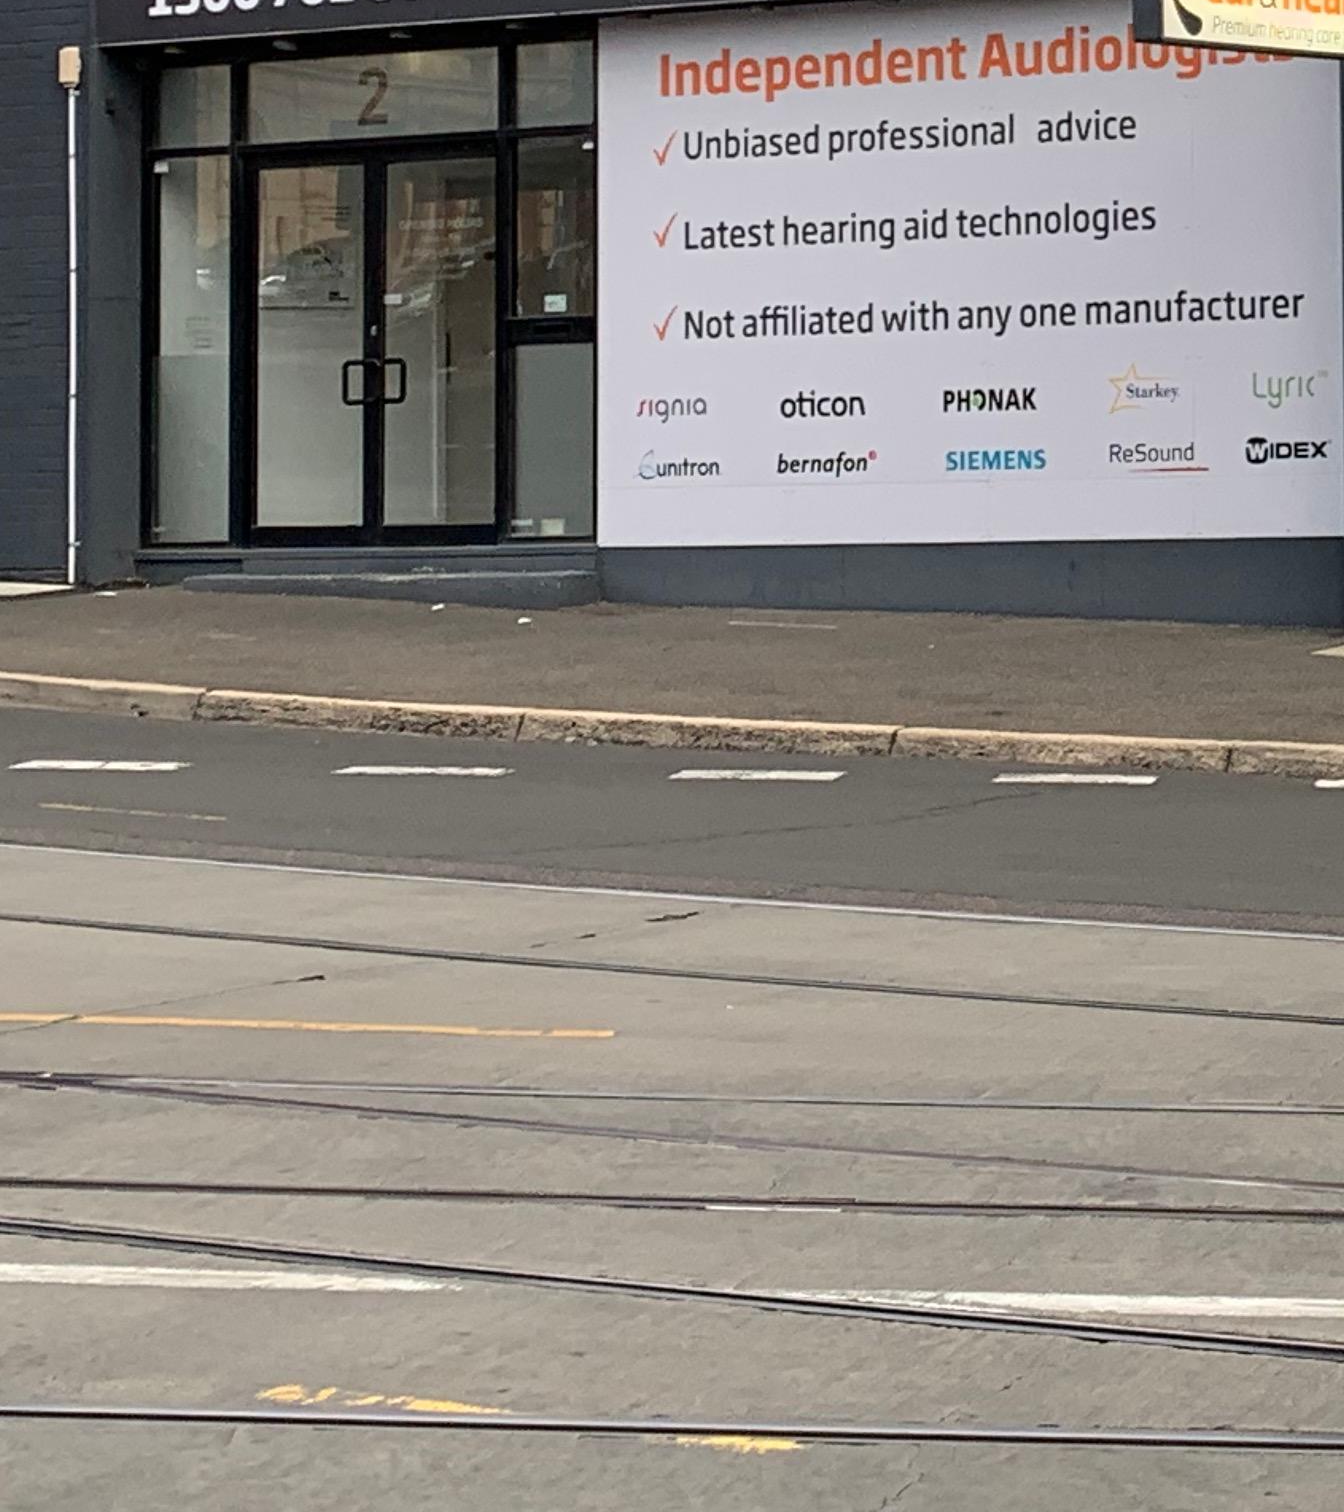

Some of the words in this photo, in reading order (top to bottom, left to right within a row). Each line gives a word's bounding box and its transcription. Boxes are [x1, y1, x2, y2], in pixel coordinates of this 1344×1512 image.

[1212, 15, 1266, 37] Premium
[1269, 21, 1313, 46] hearing
[1316, 29, 1340, 44] care
[659, 38, 966, 102] Independent
[357, 68, 388, 126] 2
[683, 124, 820, 161] Unbiased
[828, 114, 1015, 161] professional
[1037, 109, 1137, 144] advice
[684, 219, 775, 250] Latest
[783, 213, 896, 250] hearing
[903, 208, 948, 241] aid
[956, 199, 1157, 241] technologies
[684, 310, 735, 340] Not
[742, 302, 874, 338] affiliated
[881, 300, 949, 333] with
[957, 305, 1011, 337] any
[1019, 302, 1077, 328] one
[1085, 289, 1305, 325] manufacturer
[780, 390, 866, 419] oticon
[943, 387, 1037, 413] PHONAK
[1125, 382, 1179, 403] Starkey
[1252, 372, 1315, 409] Lyric
[637, 397, 707, 424] signia
[776, 451, 868, 478] bernafon
[946, 449, 1047, 471] SIEMENS
[1109, 441, 1195, 464] ReSound
[1245, 436, 1328, 465] WIDEX
[656, 457, 720, 478] unitron
